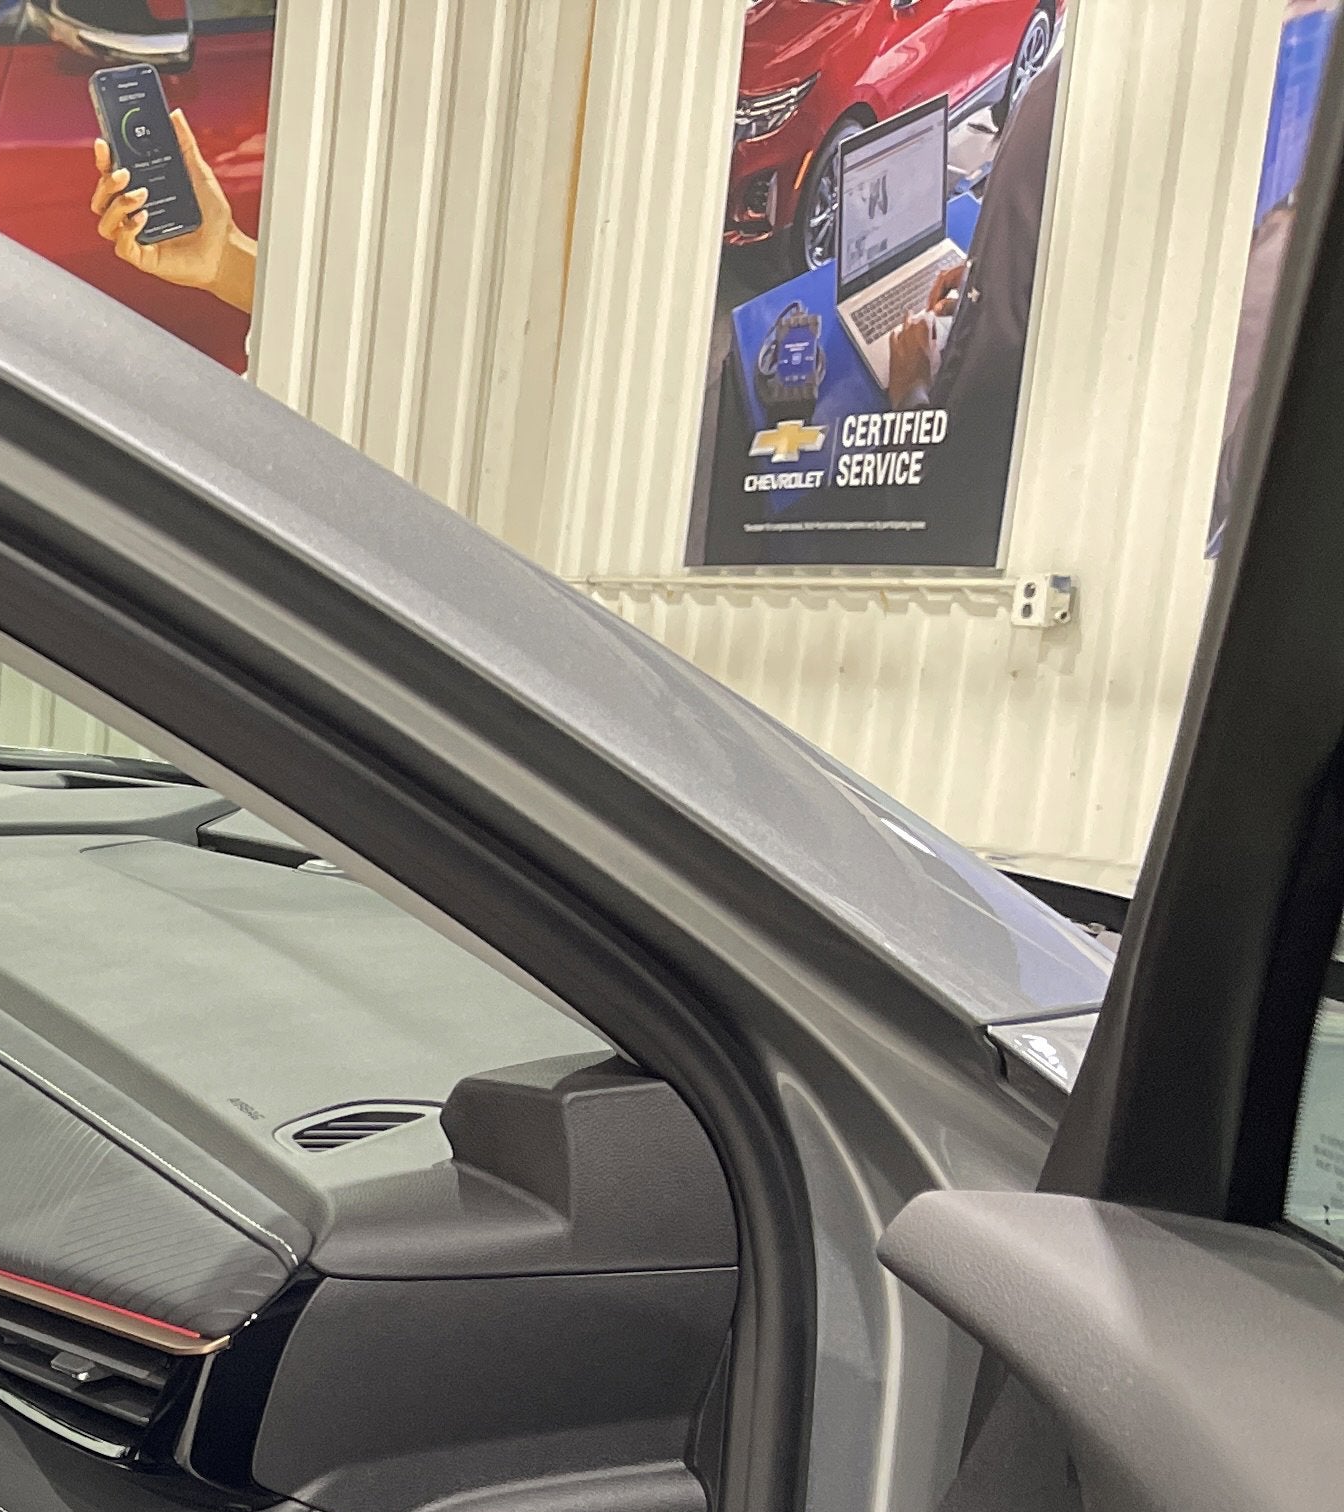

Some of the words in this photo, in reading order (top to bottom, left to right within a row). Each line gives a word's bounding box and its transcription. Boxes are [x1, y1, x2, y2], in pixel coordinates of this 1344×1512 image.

[842, 409, 947, 447] CERTIFIED
[744, 471, 824, 492] CHEVROLET
[836, 451, 925, 486] SERVICE
